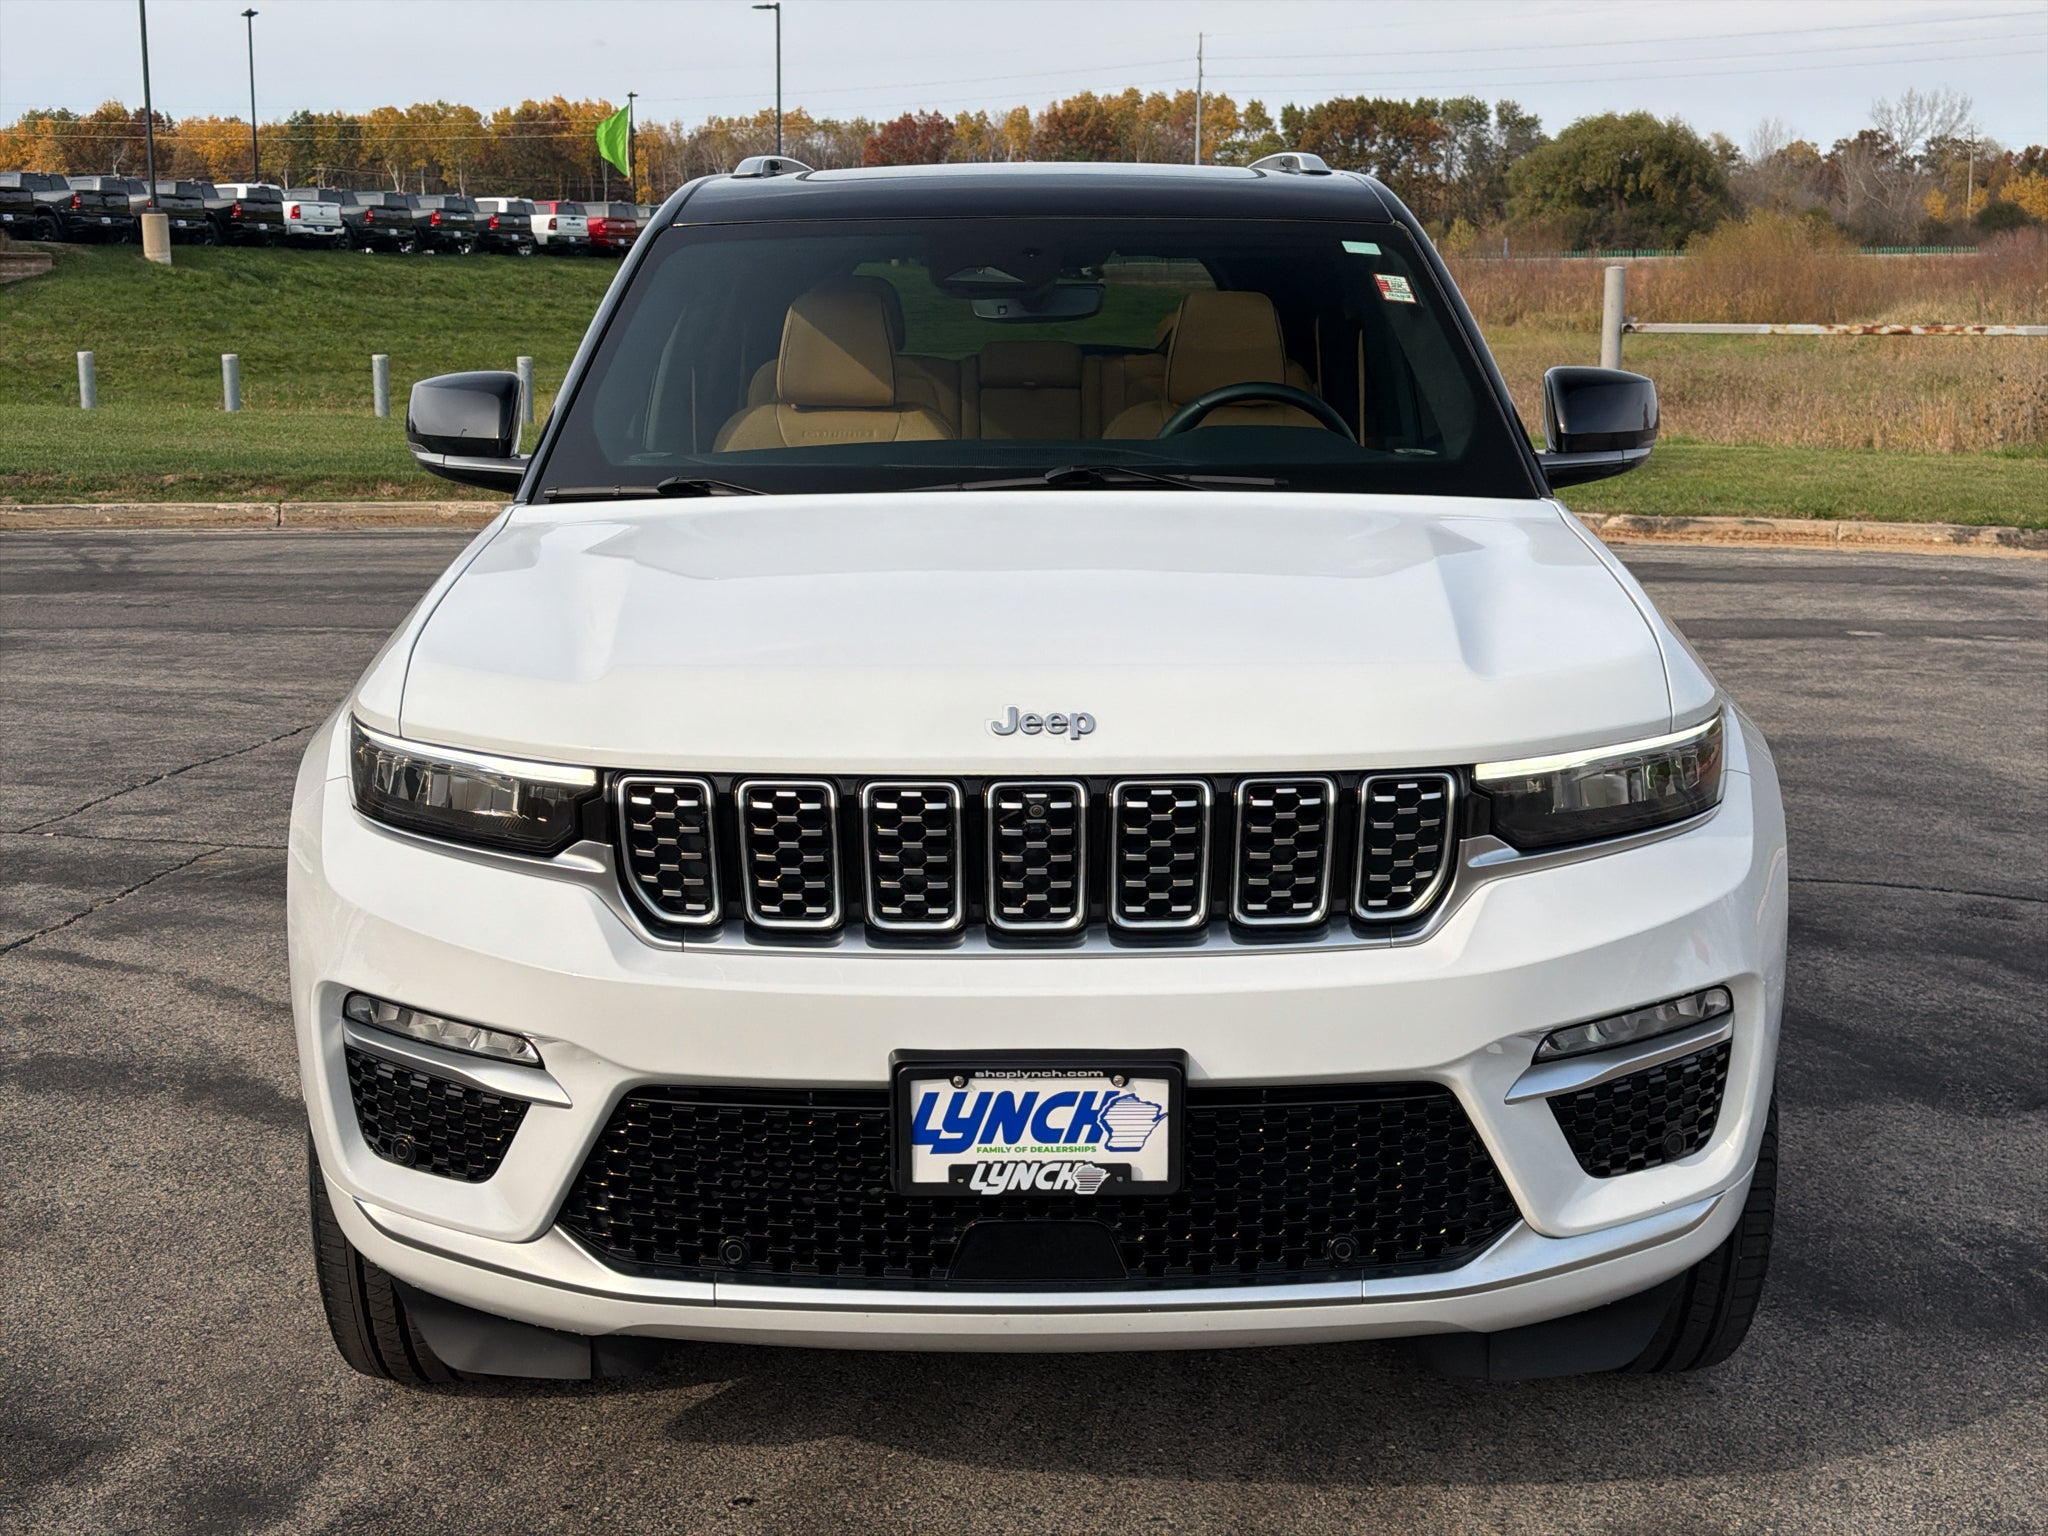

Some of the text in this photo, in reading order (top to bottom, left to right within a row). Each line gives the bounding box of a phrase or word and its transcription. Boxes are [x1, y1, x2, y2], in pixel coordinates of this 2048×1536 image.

[990, 706, 1096, 741] Jeep
[974, 1070, 1104, 1079] shoplynch.com
[911, 1090, 1120, 1155] LYNCH
[976, 1146, 1012, 1154] FAMILY
[1030, 1145, 1097, 1153] DEALERSHIPS
[969, 1161, 1083, 1195] LYNCH
